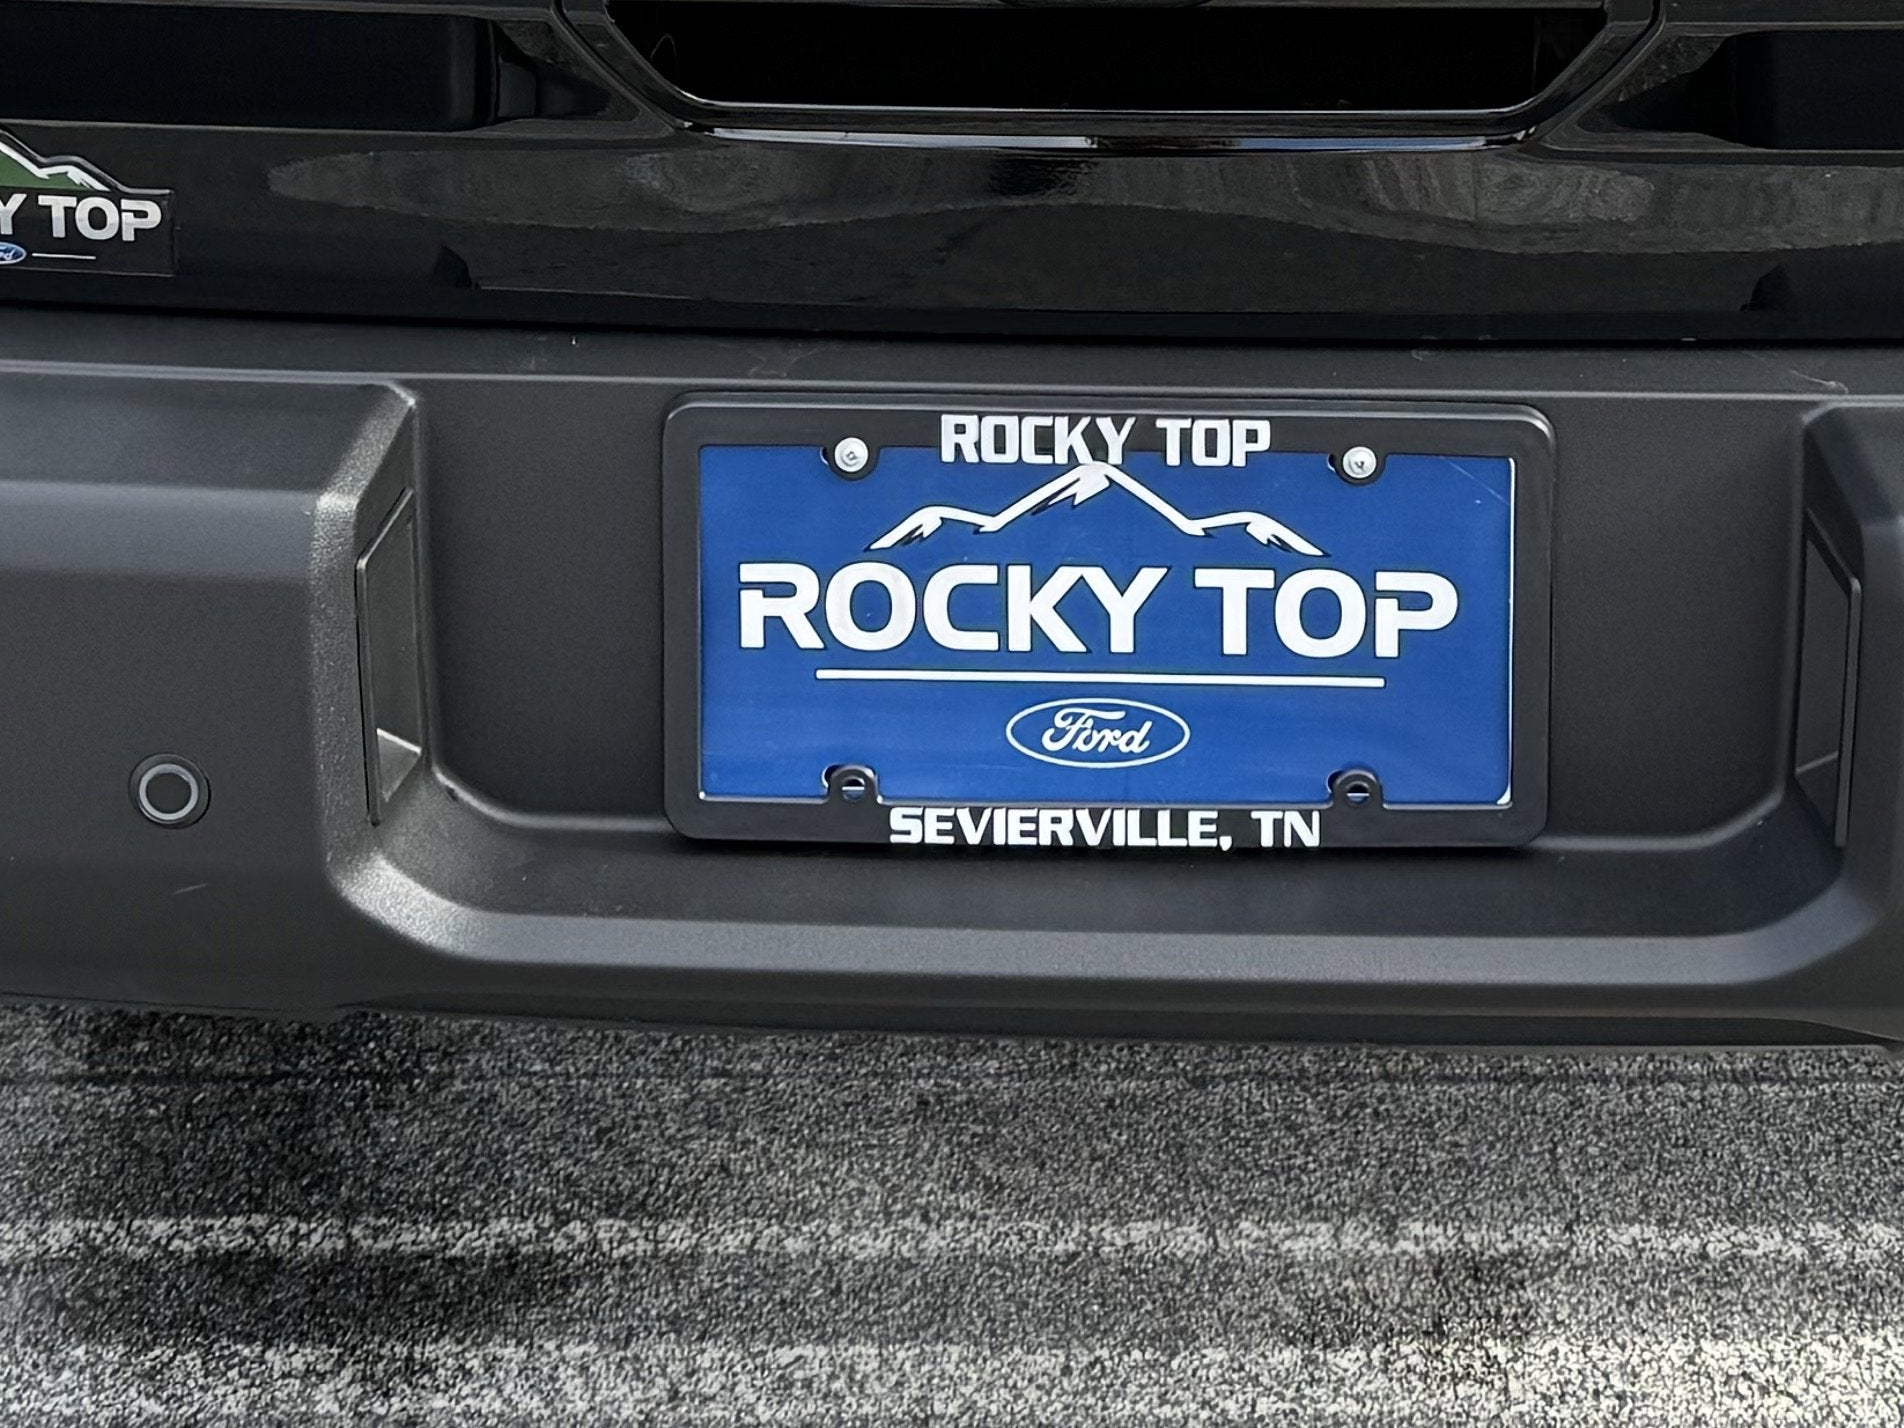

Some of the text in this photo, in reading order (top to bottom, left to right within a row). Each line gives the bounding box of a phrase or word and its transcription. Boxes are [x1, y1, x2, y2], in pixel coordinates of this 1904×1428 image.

[38, 194, 163, 243] TOP
[940, 413, 1272, 468] ROCKY TOP
[737, 560, 1461, 660] ROCKY TOP
[1041, 707, 1153, 754] Ford
[888, 806, 1323, 853] SEVIERVILLE, TN
